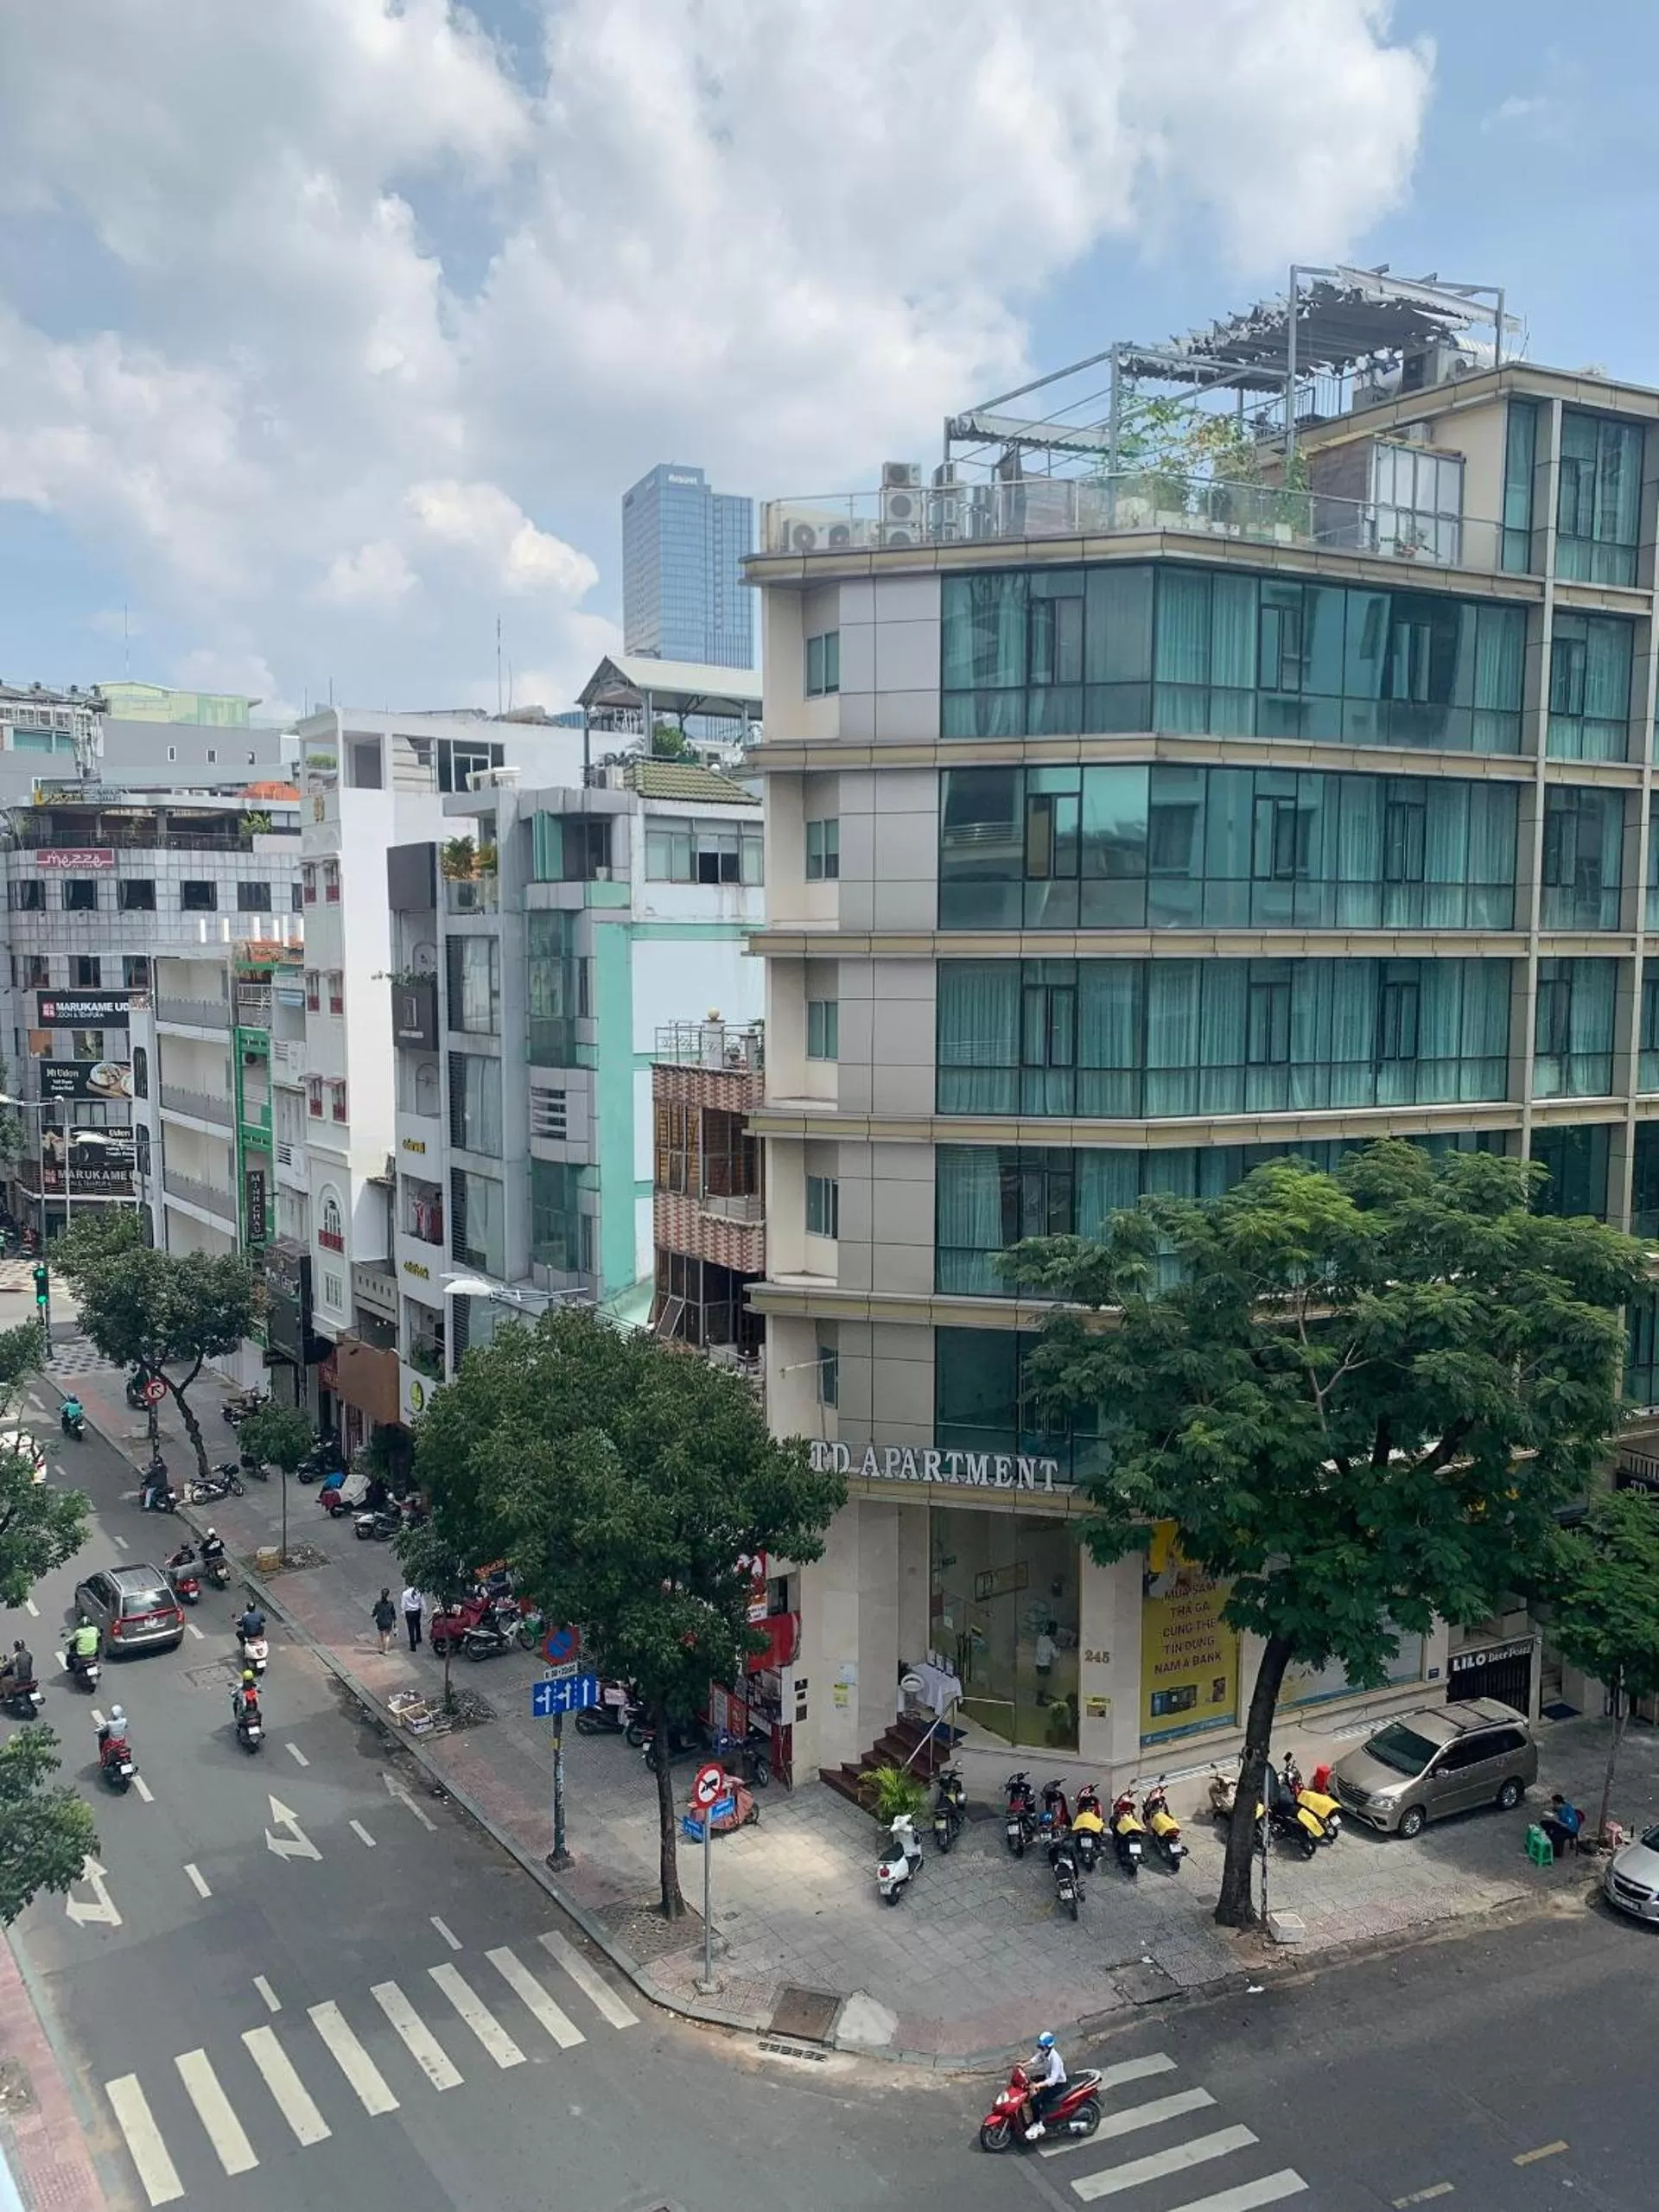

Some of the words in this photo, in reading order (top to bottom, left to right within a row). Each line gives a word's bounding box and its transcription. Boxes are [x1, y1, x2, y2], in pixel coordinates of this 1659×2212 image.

[56, 1002, 113, 1012] MARUKAME
[861, 1445, 1058, 1492] APARTMENT
[1154, 1660, 1180, 1675] NAM
[1192, 1651, 1222, 1667] BANK
[1452, 1653, 1486, 1672] LILO
